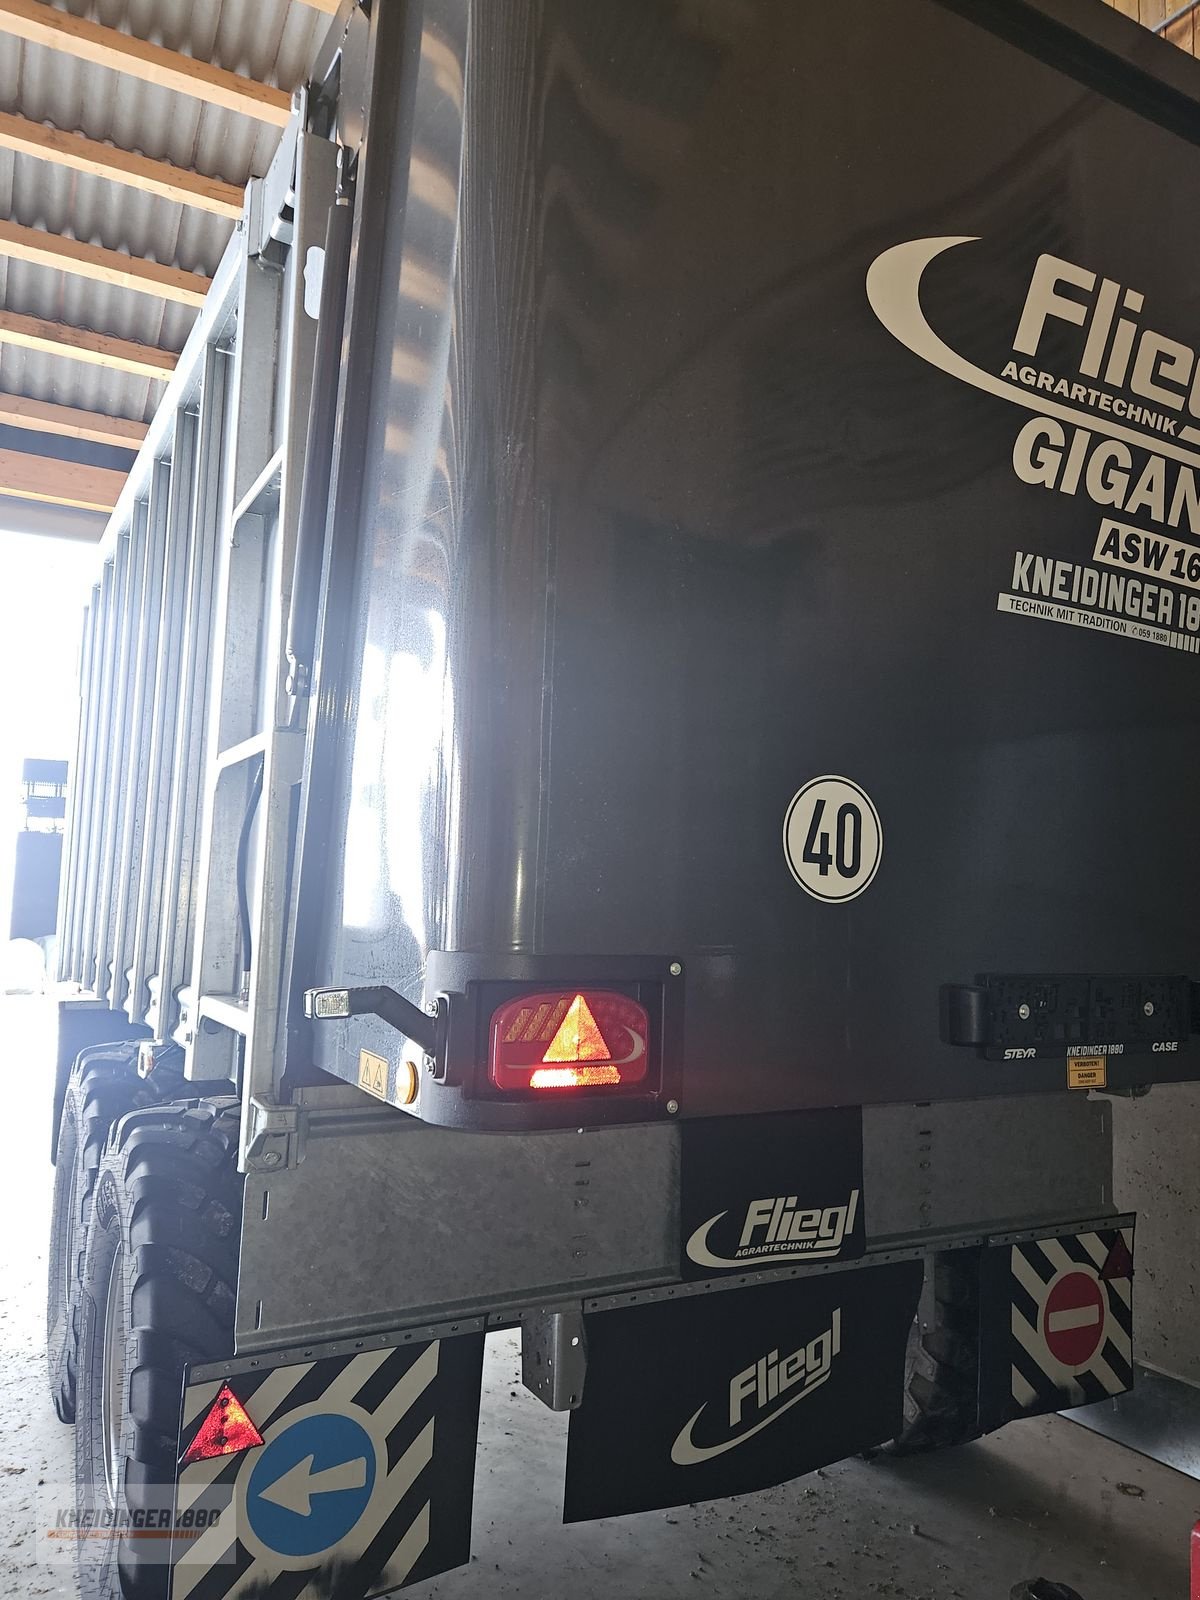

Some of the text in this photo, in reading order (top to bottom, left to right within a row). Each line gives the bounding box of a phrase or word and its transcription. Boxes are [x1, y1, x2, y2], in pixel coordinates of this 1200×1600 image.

[1012, 253, 1200, 445] Flie
[1000, 360, 1178, 436] AGRARTECHNIK
[1100, 527, 1200, 582] ASW 16
[1009, 598, 1053, 617] TECHNIK
[1056, 608, 1076, 621] MIT
[1077, 613, 1127, 633] TRADITION
[1012, 551, 1200, 631] KNEIDINGER 18
[803, 799, 862, 878] 40
[1004, 1048, 1036, 1059] STEYR
[1067, 1044, 1124, 1056] KNEIDINGER 1880
[1152, 1041, 1178, 1052] CASE
[738, 1189, 860, 1248] Fliegl
[735, 1241, 815, 1257] AGRARTECHNIK
[729, 1307, 841, 1427] Fliegl
